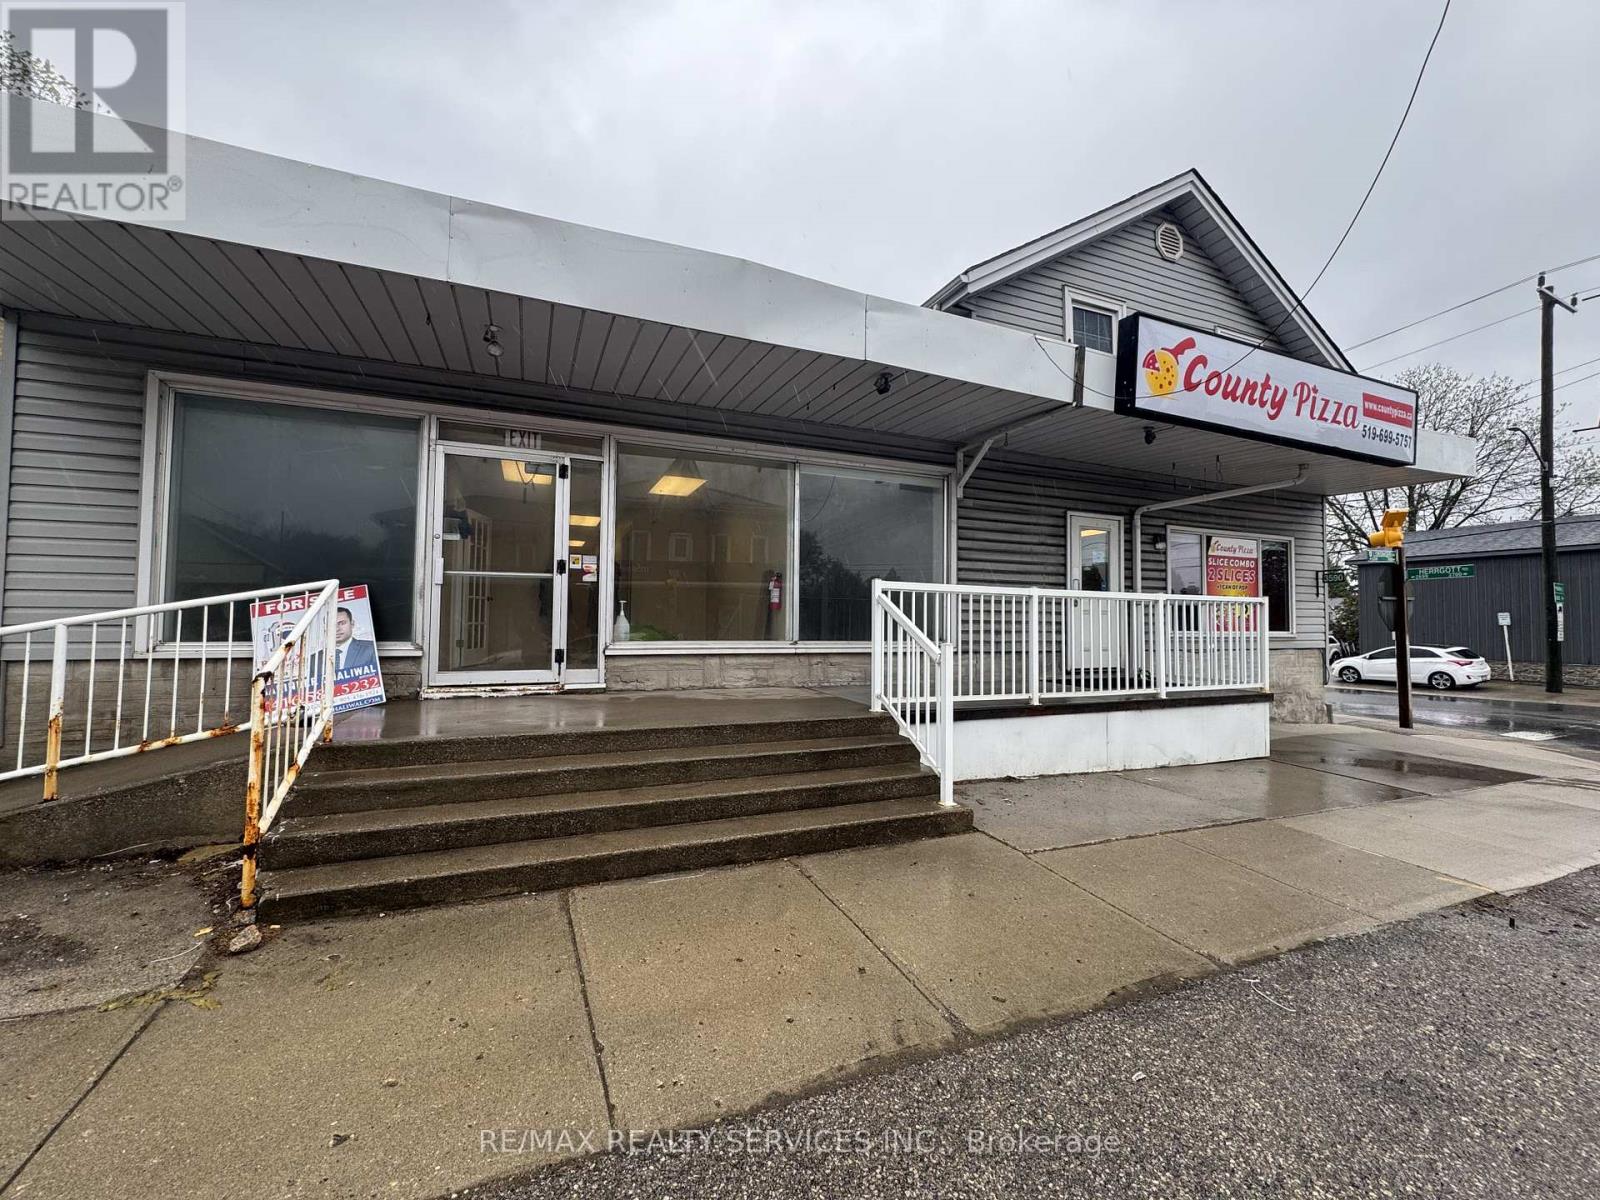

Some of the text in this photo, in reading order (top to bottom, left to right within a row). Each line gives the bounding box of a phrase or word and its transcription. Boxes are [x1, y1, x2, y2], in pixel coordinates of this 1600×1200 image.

[1183, 354, 1360, 430] County Pizza
[510, 430, 540, 449] EXIT
[1361, 424, 1412, 449] 519-699-5757
[1208, 558, 1255, 568] SLICE COMBO
[1208, 568, 1256, 584] 2 SLICES
[265, 588, 356, 614] FOR SE
